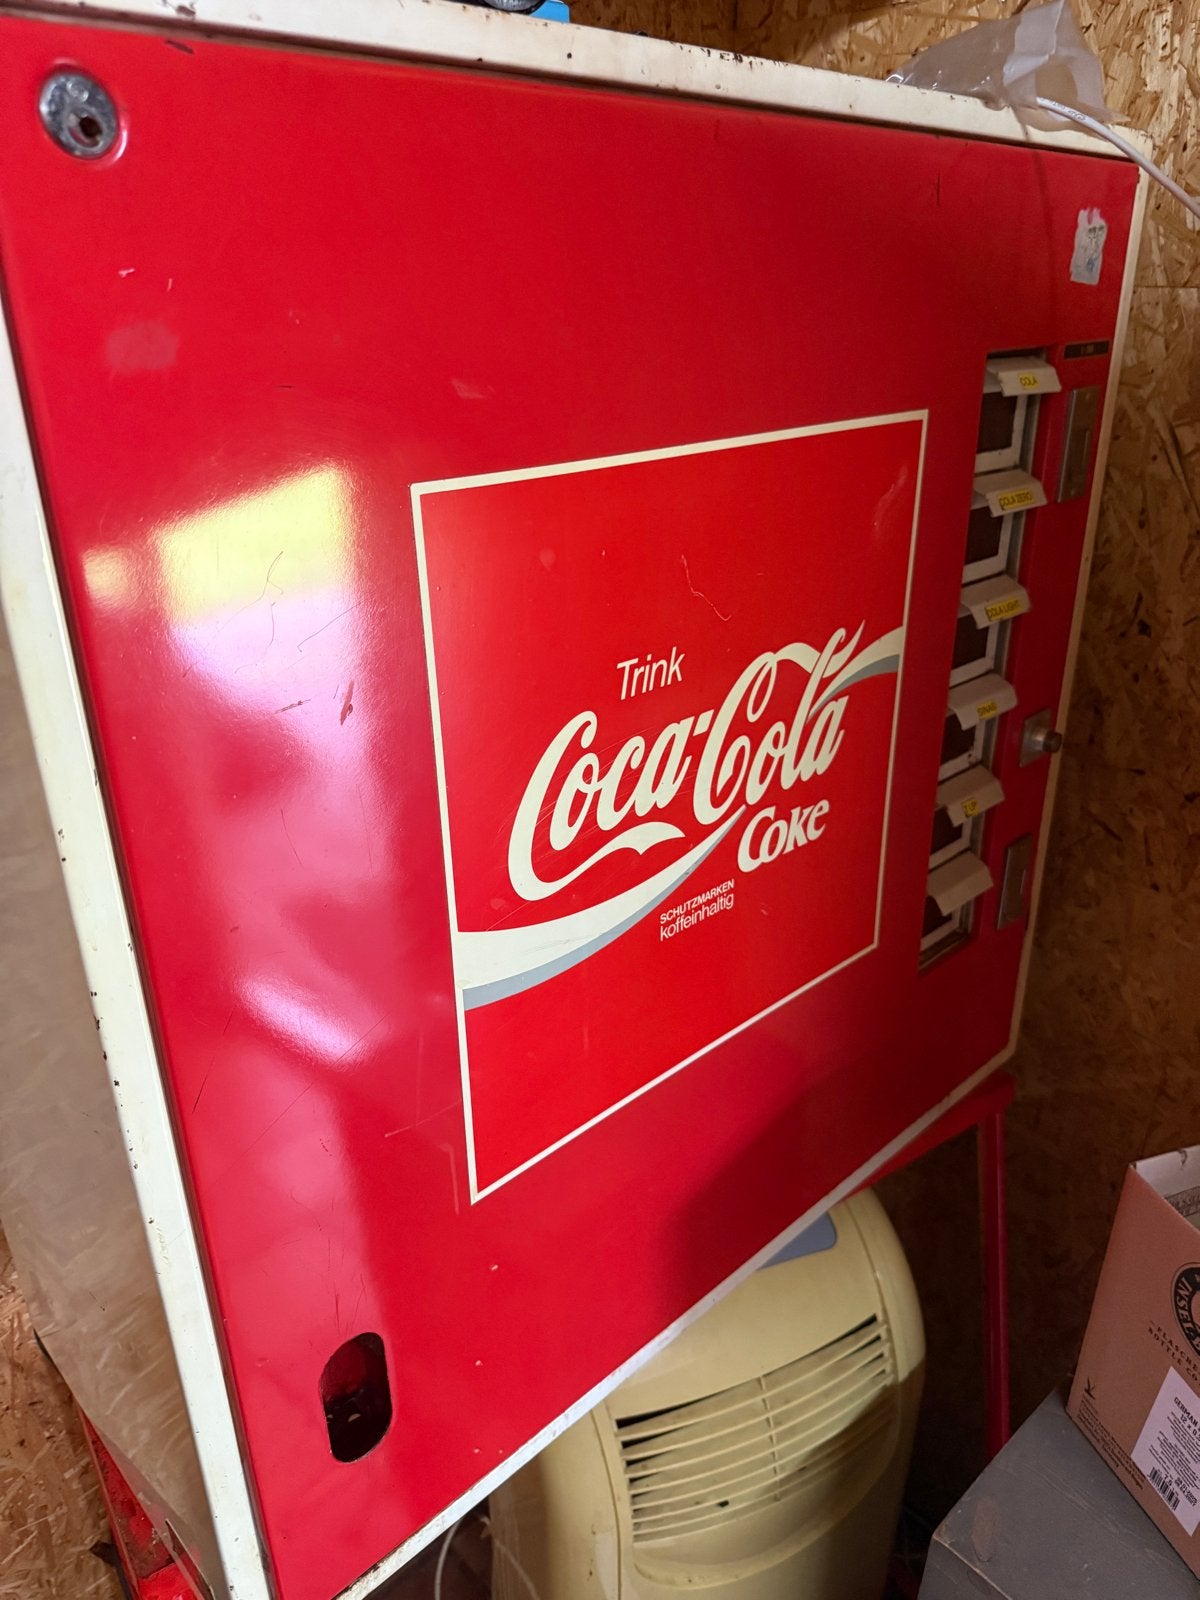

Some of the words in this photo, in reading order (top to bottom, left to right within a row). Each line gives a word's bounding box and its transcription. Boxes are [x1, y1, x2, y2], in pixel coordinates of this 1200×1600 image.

[616, 646, 686, 701] Trink
[508, 619, 866, 902] Coca-Cola
[737, 799, 830, 873] Coke
[660, 878, 735, 924] SCHUTZMARKEN
[660, 893, 735, 942] koffeinhaltig
[1148, 1326, 1182, 1366] BOTTLE
[1174, 1396, 1198, 1428] GERMAN
[1180, 1413, 1188, 1424] 12
